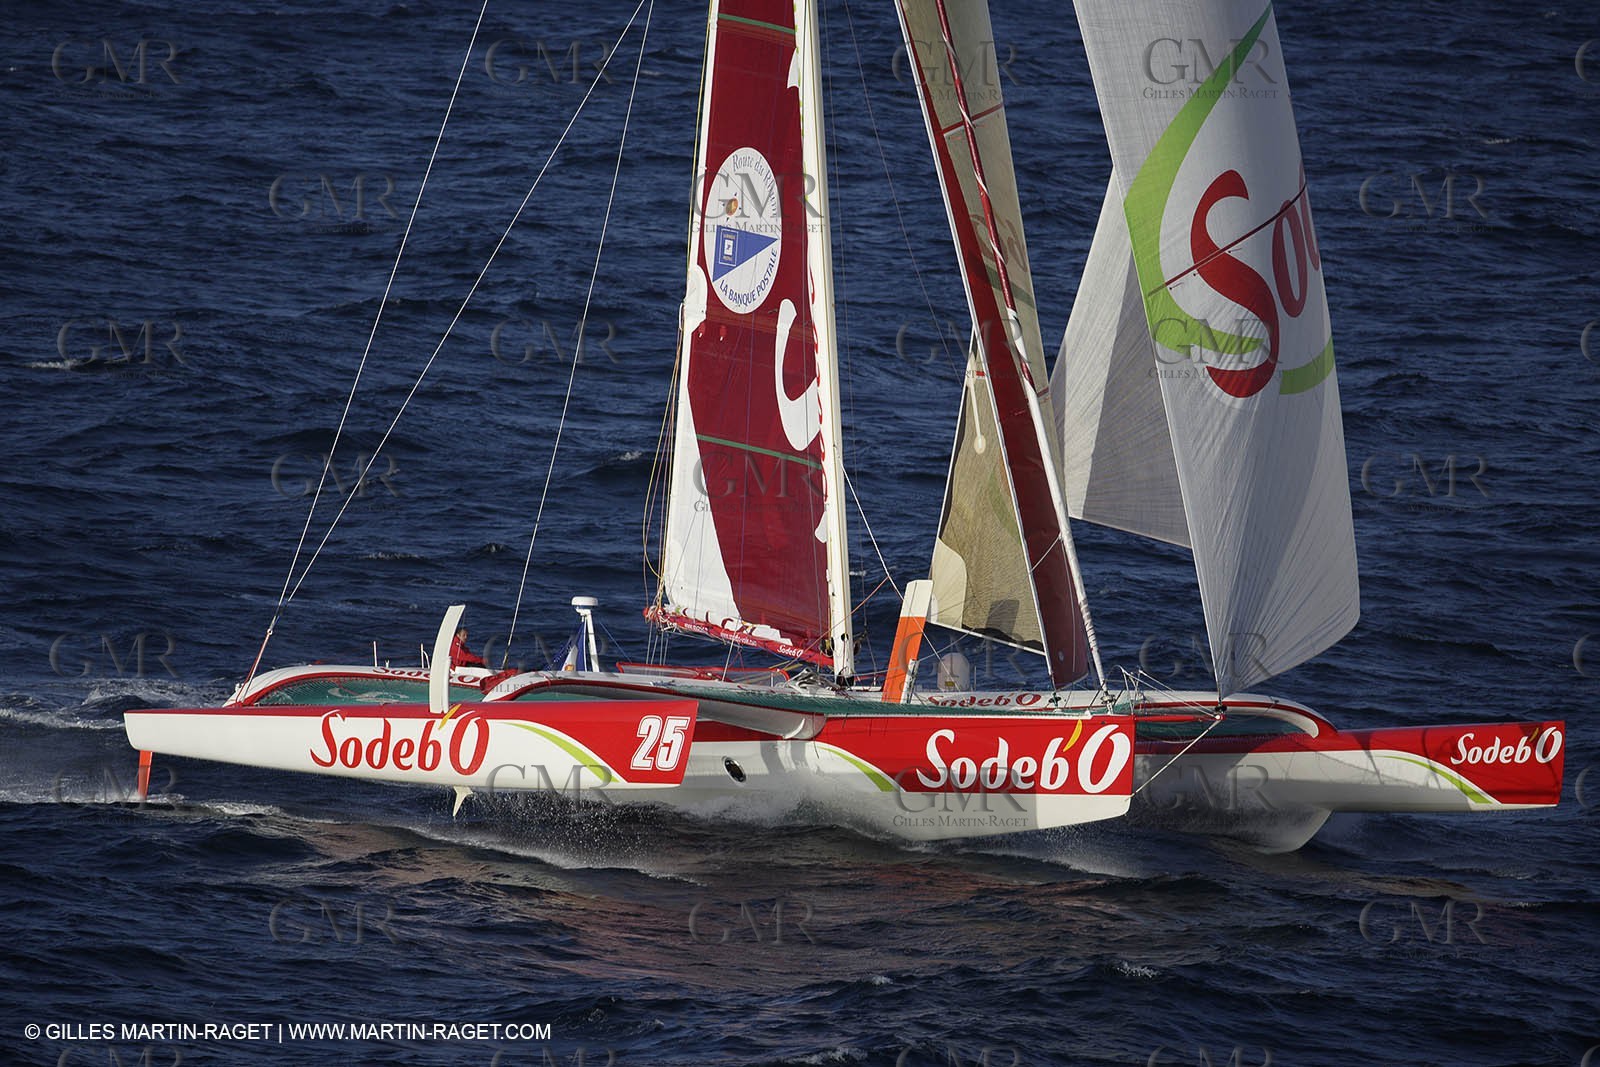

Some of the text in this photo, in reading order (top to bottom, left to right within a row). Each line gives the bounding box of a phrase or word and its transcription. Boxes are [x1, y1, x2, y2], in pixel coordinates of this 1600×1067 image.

[719, 248, 778, 307] LA BANQUE POSTALE
[310, 704, 490, 776] Sodeb'O
[630, 715, 691, 772] 25
[916, 719, 1132, 795] Sodeb'O
[1450, 725, 1564, 766] Sodeb'O
